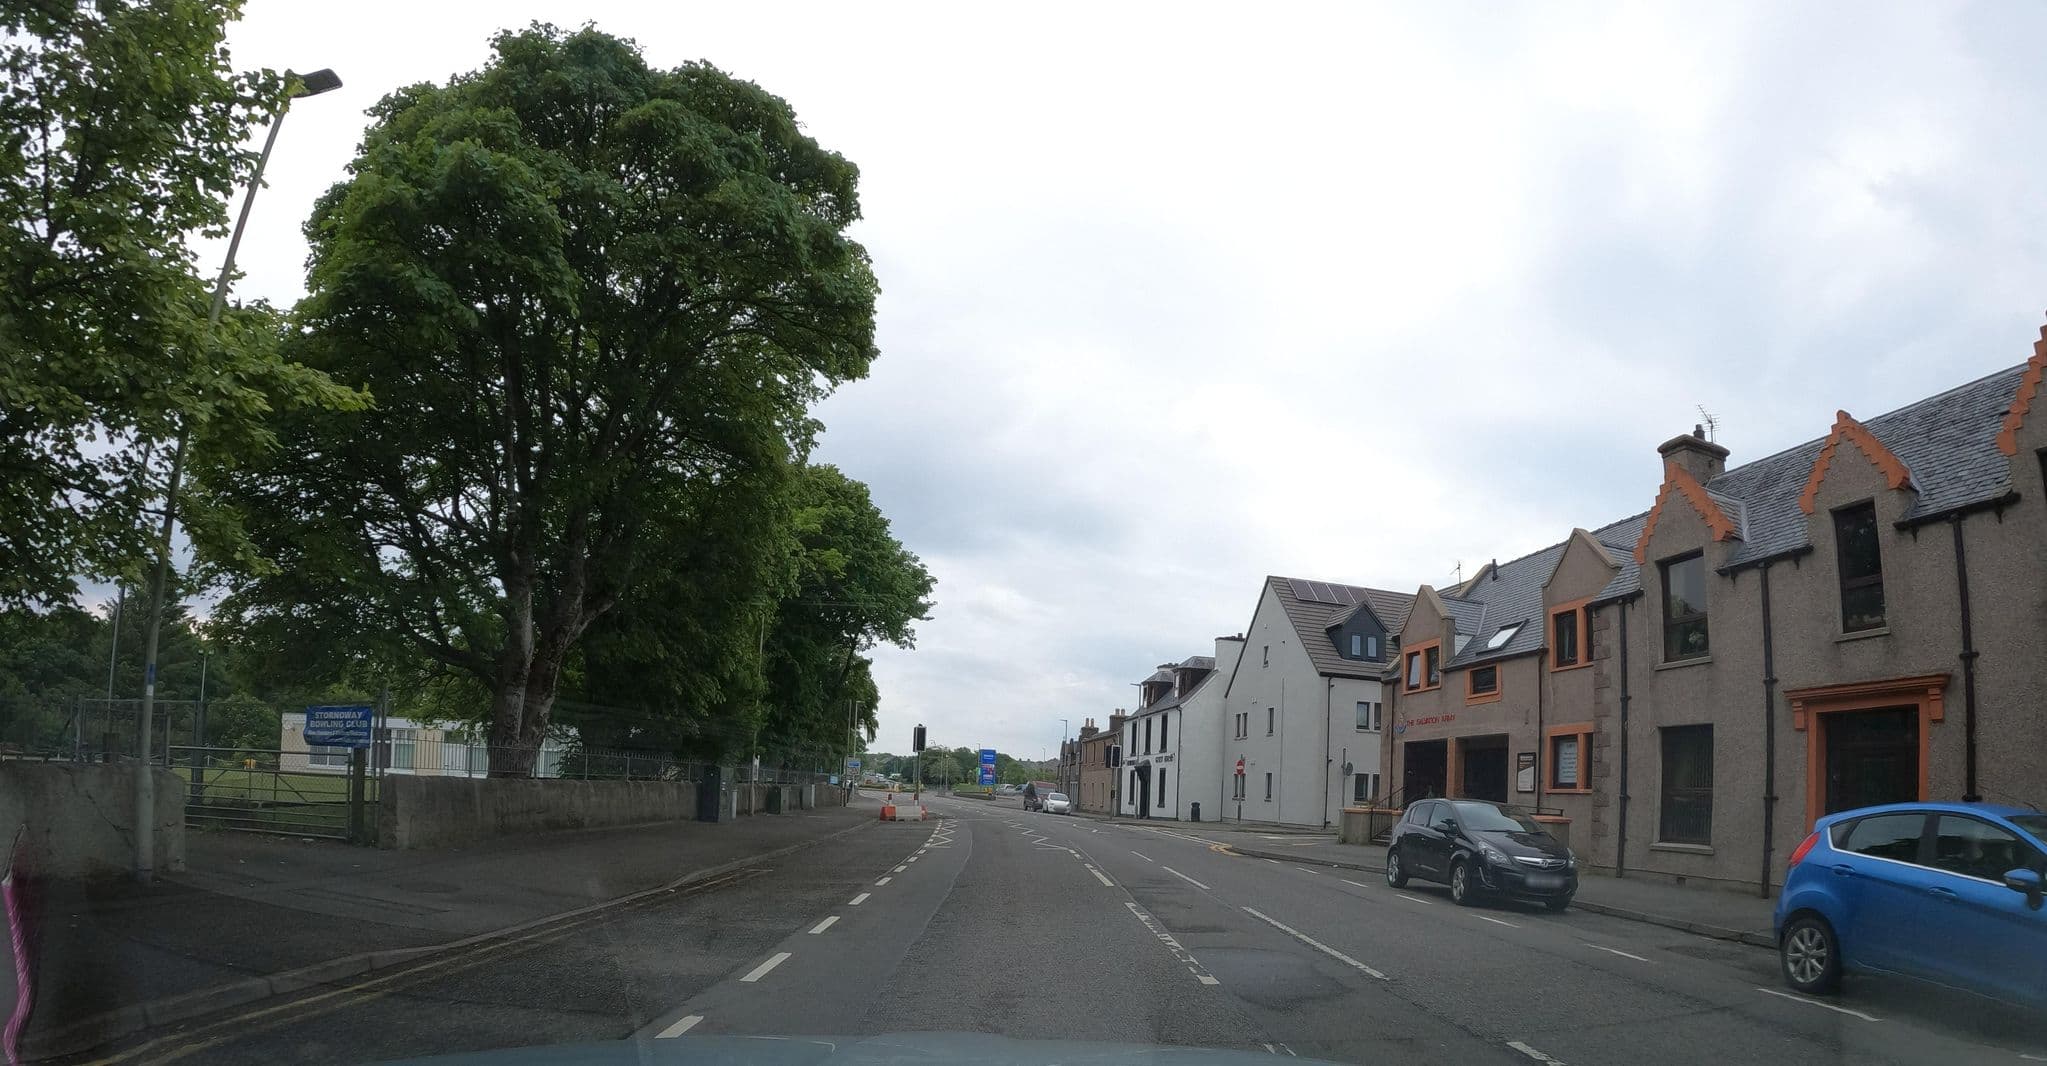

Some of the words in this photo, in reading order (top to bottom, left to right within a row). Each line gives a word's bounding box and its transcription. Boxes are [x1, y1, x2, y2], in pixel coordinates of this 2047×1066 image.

[315, 711, 363, 719] STORNOWAY
[310, 720, 344, 728] BOWLING
[345, 720, 368, 728] CLUB
